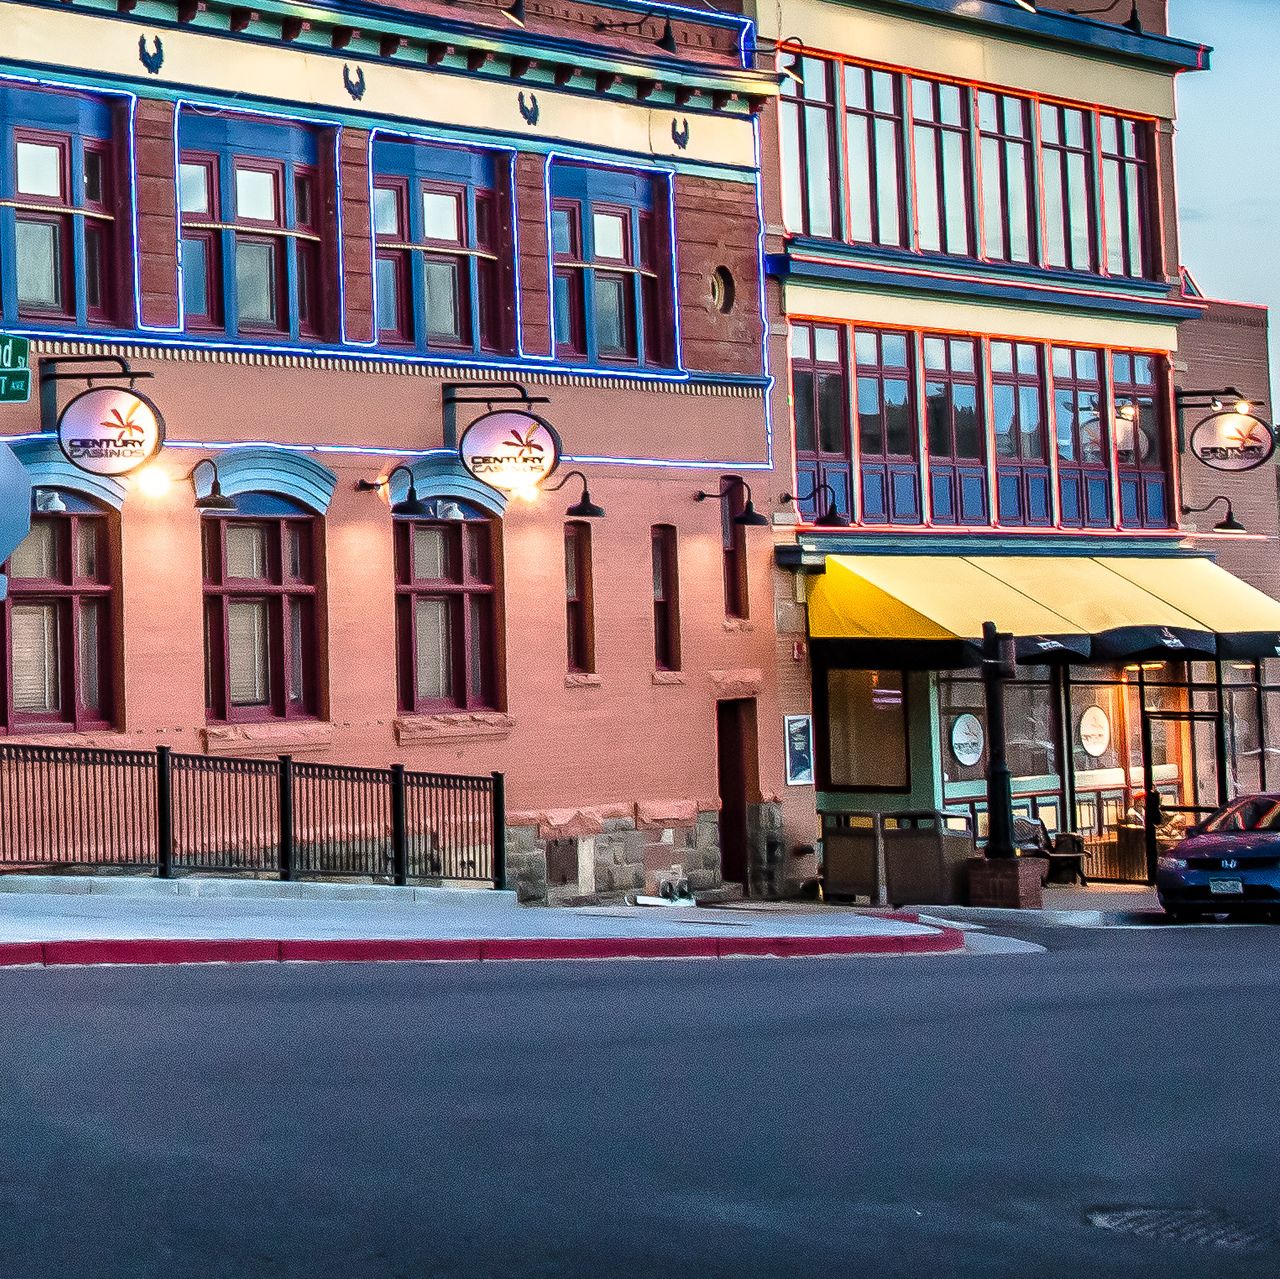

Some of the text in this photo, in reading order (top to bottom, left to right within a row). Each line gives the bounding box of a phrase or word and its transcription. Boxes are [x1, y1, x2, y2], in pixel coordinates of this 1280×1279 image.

[69, 438, 144, 448] CENTURY
[70, 448, 144, 458] CASINOS
[471, 456, 544, 464] CENTURY
[472, 464, 544, 472] CASOS
